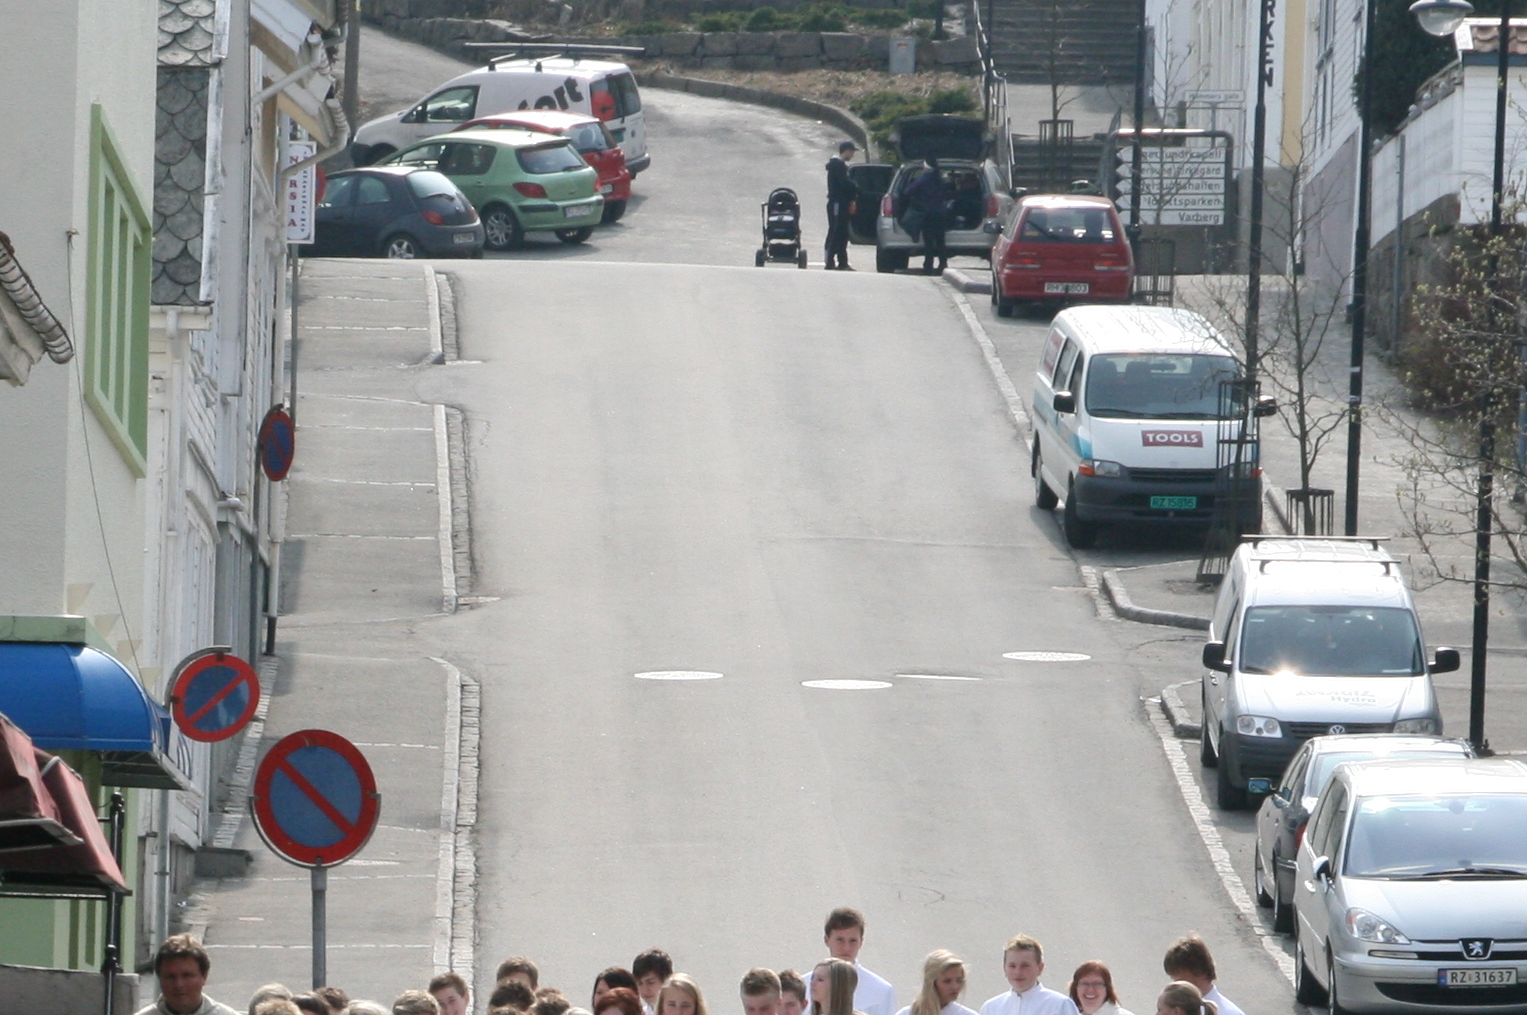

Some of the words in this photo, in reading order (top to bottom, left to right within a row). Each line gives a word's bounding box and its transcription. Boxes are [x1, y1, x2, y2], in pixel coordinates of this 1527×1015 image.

[287, 156, 299, 227] NRSIA
[1178, 212, 1220, 223] Varberg
[1146, 433, 1199, 443] TOOLS
[1330, 696, 1377, 704] Hydro
[1450, 971, 1467, 983] RZ
[1474, 971, 1513, 983] 31637
